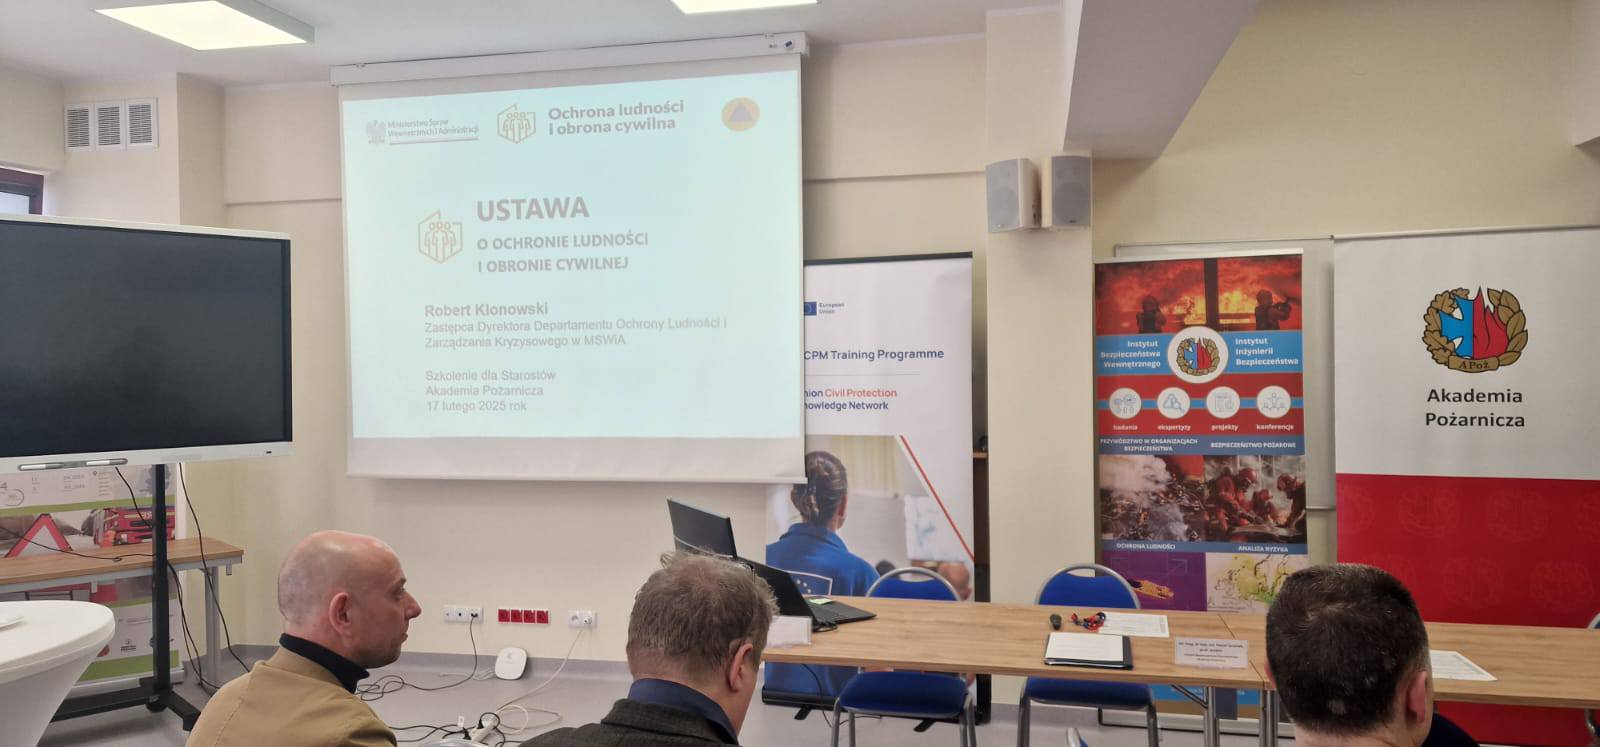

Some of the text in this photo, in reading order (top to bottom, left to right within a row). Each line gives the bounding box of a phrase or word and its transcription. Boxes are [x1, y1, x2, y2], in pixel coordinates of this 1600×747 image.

[548, 100, 684, 122] Ochrona ludności
[556, 119, 611, 135] obrona
[615, 117, 676, 134] cywilna
[477, 196, 590, 222] USTAWA
[477, 231, 648, 250] O OCHRONIE LUDNOŚCI
[478, 256, 629, 273] I OBRONIE CYWILNEJ
[425, 302, 548, 317] Robert Klonowski
[425, 321, 474, 336] Zastępca
[478, 320, 530, 334] Dyrektora
[534, 319, 612, 333] Departamentu
[616, 318, 664, 332] Ochrony
[668, 317, 720, 329] Ludności
[425, 336, 491, 350] Zarządzania
[495, 335, 568, 348] Kryzysowego
[804, 349, 944, 361] CPM Training Programme
[1236, 347, 1273, 356] Inżynierii
[1236, 358, 1298, 366] Bezpieczeństwa
[426, 369, 556, 381] Szkolenie dla Starostów
[426, 384, 543, 397] Akademia Pożarnicza
[825, 389, 844, 397] Civil
[847, 389, 897, 397] Protection
[1427, 388, 1522, 402] Akademia
[427, 401, 527, 413] 17 lutego 2025 rok
[849, 402, 888, 410] Network
[1426, 412, 1525, 426] Pożarnicza
